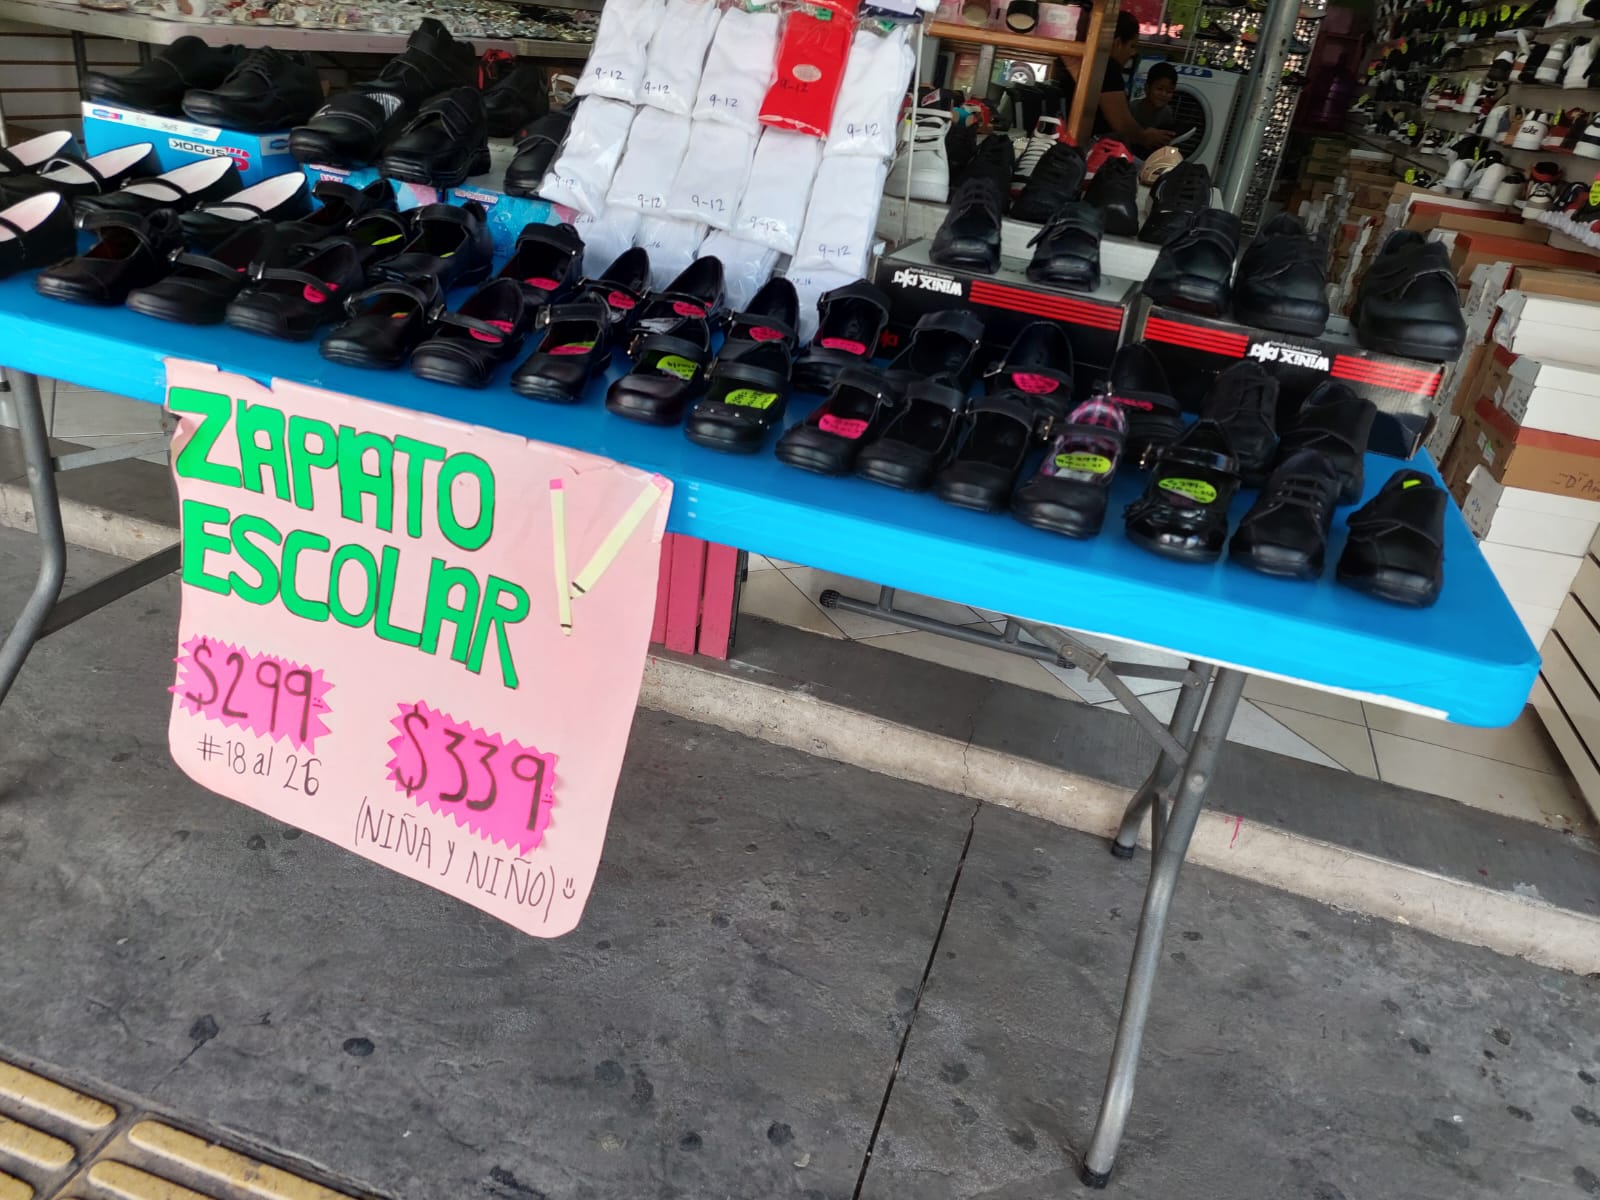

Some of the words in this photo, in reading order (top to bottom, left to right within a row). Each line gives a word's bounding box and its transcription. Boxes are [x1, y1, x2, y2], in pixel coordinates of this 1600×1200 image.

[594, 67, 625, 81] 9-12
[644, 81, 671, 95] 9-12
[709, 93, 738, 108] 9-12
[846, 122, 881, 140] 9-12
[637, 193, 663, 209] 9-12
[691, 194, 726, 212] 9-12
[750, 215, 780, 233] 9-12
[818, 243, 852, 260] 9-12
[168, 387, 496, 551] ZAPATO
[182, 499, 531, 690] ESCOLAR
[196, 733, 246, 775] #18
[253, 746, 274, 777] al
[283, 754, 322, 796] 26
[355, 796, 432, 869] (NIÑA
[466, 850, 555, 923] NIÑO)
